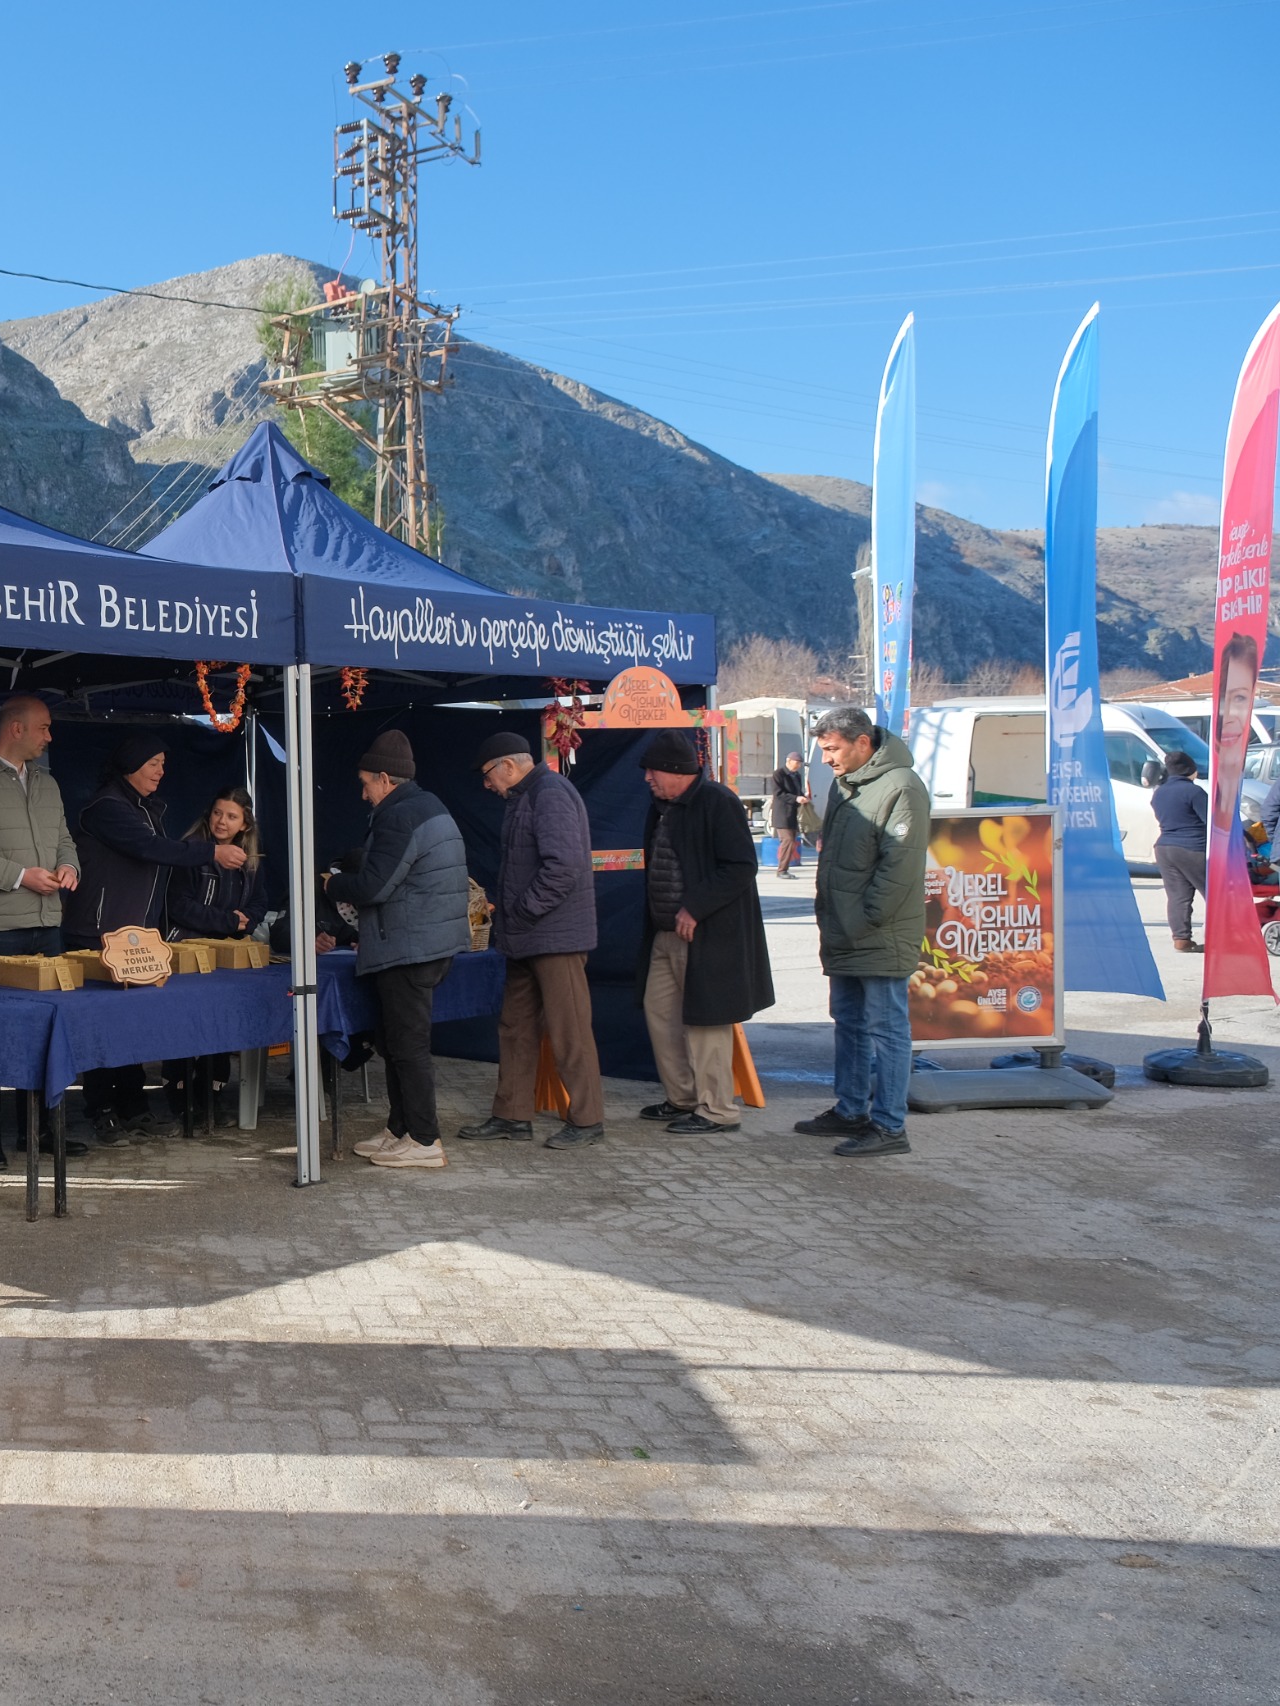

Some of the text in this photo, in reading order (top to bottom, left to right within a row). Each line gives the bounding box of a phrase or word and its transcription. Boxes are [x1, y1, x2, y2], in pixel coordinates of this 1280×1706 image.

[98, 584, 258, 639] BELEDİYESİ
[344, 586, 695, 667] Hayallerin gerçeğe dönüştüğü şehir
[944, 865, 1008, 907] YEREL
[962, 896, 1041, 931] TOHUM
[121, 962, 164, 975] MERKEZİ
[123, 947, 151, 956] YEREL
[124, 956, 156, 965] TOHUM
